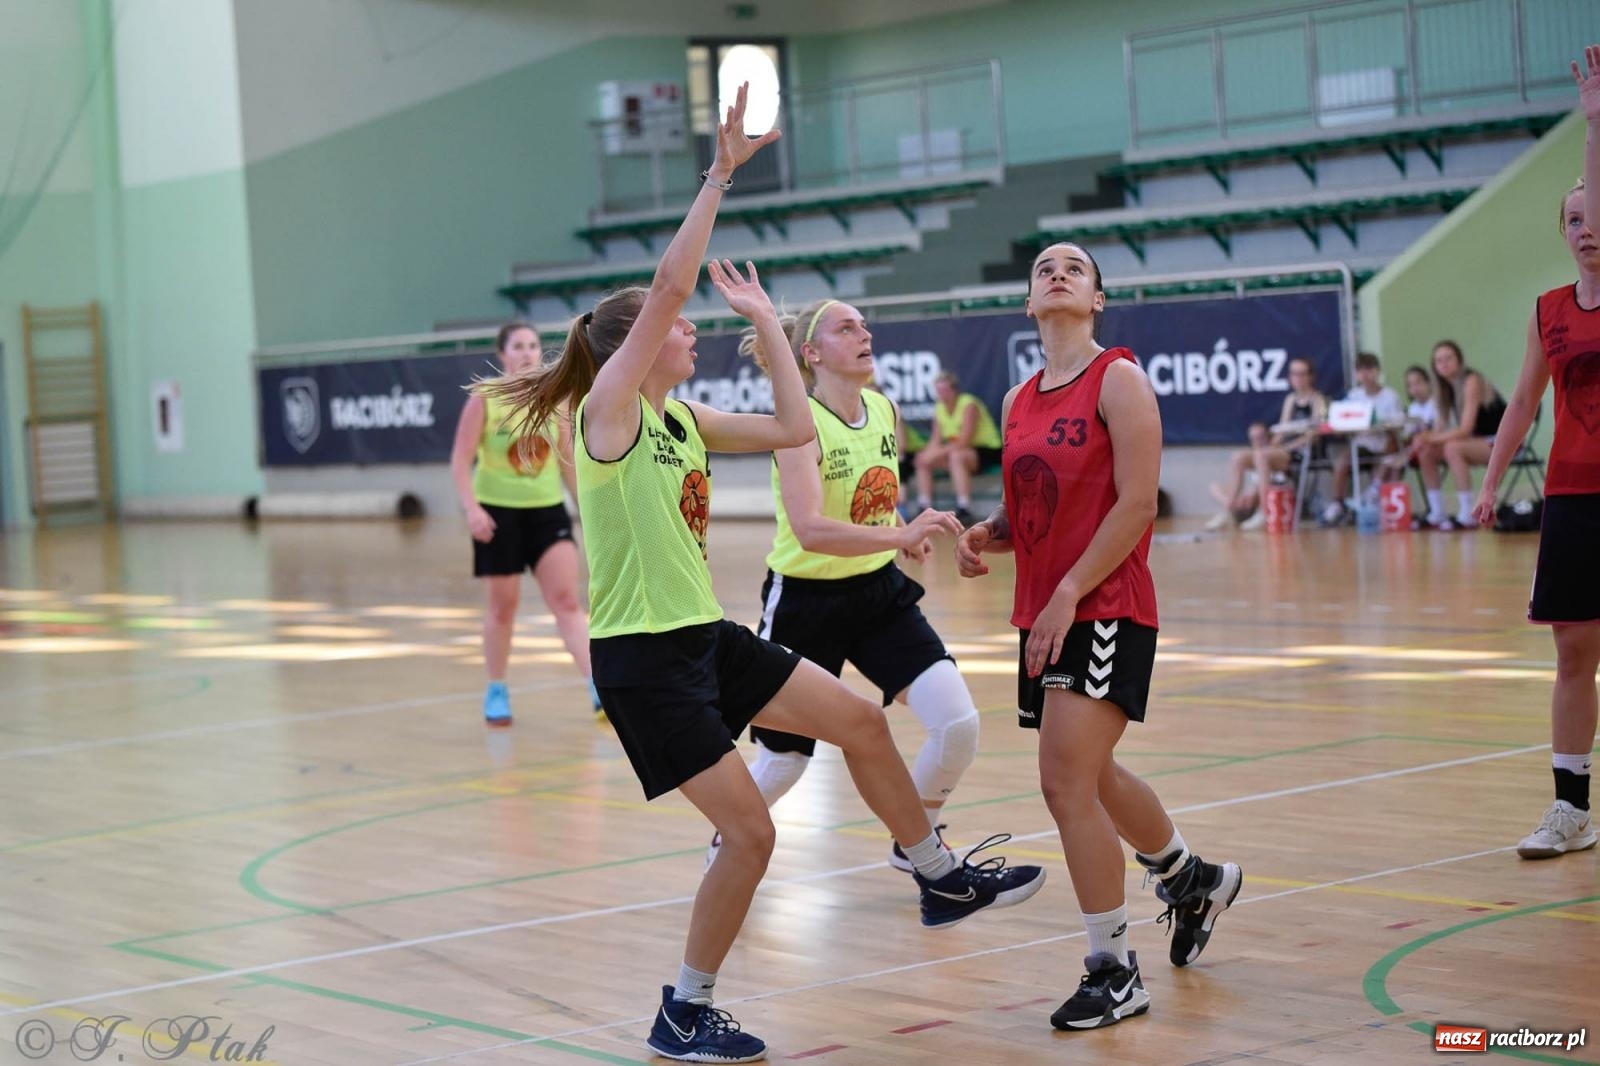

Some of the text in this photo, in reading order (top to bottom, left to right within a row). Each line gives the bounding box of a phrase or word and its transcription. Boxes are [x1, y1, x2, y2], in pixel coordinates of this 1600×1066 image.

[1140, 337, 1290, 396] CIBÓRZ
[330, 384, 435, 430] RACIBÓRZ
[881, 432, 897, 459] 48
[1047, 417, 1088, 448] 53
[824, 468, 854, 481] KOBIET
